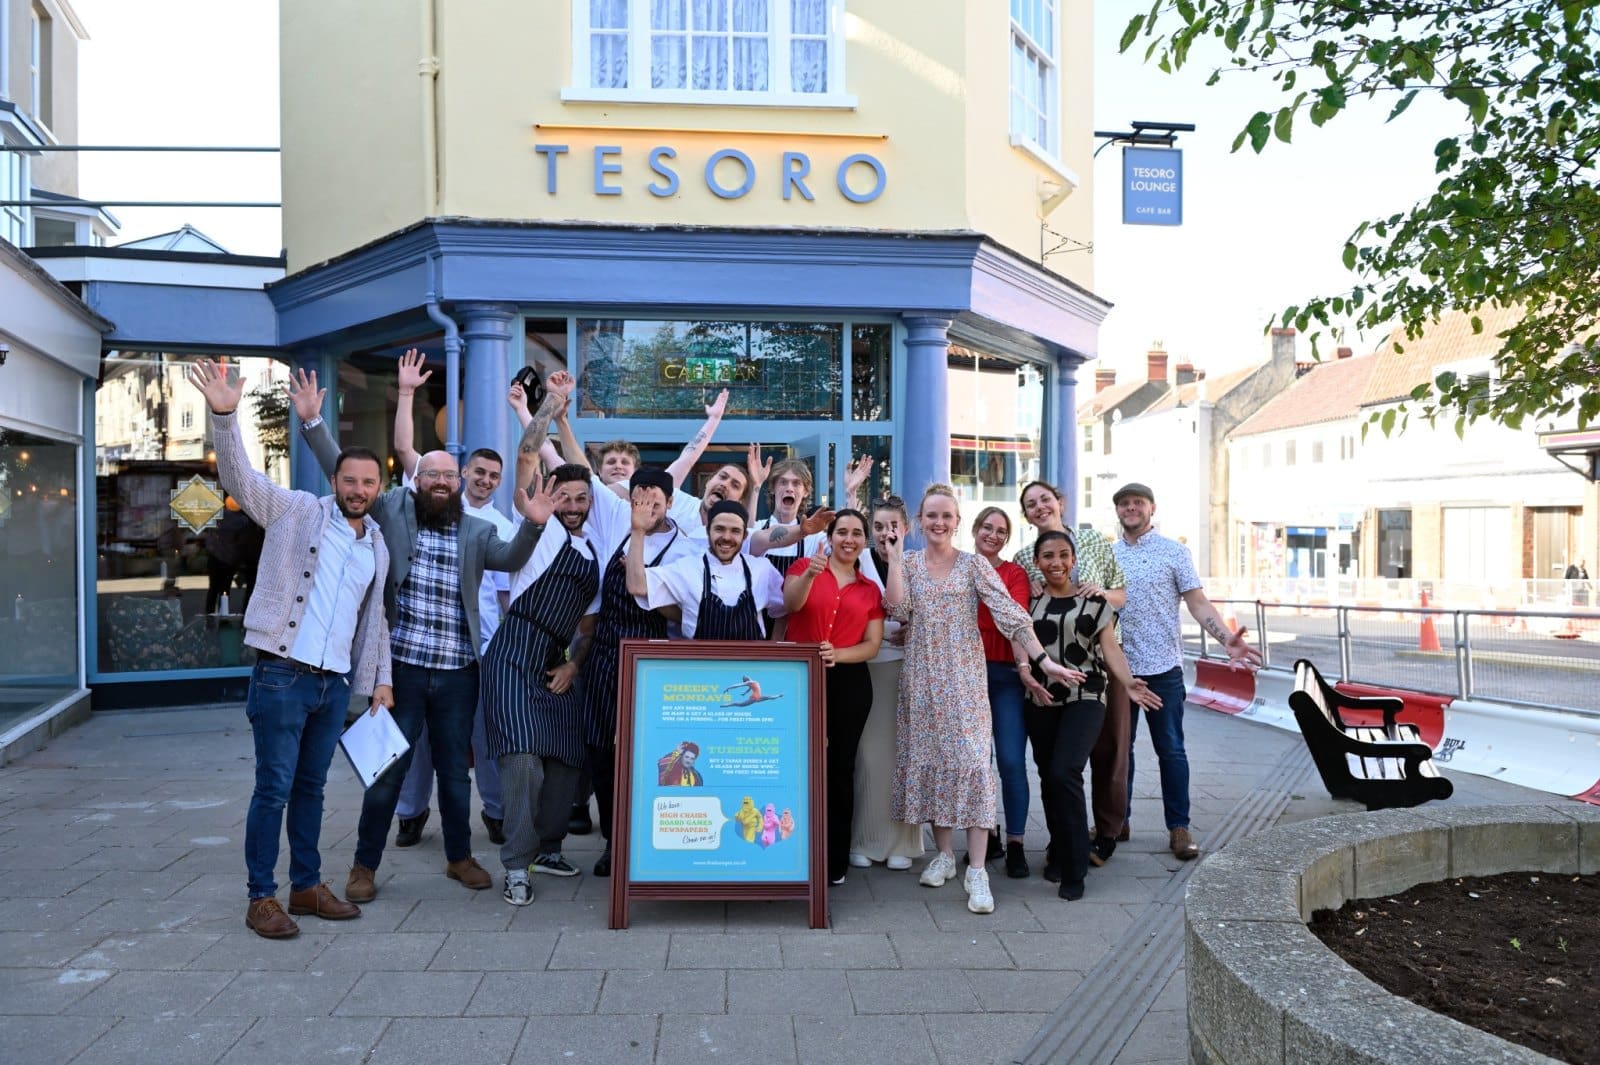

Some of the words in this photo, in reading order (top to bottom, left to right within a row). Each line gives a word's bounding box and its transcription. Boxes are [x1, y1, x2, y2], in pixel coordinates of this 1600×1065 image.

[535, 144, 888, 204] TESORO
[1133, 167, 1176, 179] TESORO
[1131, 181, 1177, 193] LOUNGE
[1157, 207, 1172, 215] BAR
[721, 364, 757, 381] BAR
[663, 684, 719, 693] CHEEKY
[663, 694, 732, 703] MONDAYS
[736, 736, 779, 745] TAPAS
[708, 746, 779, 754] TUESDAYS
